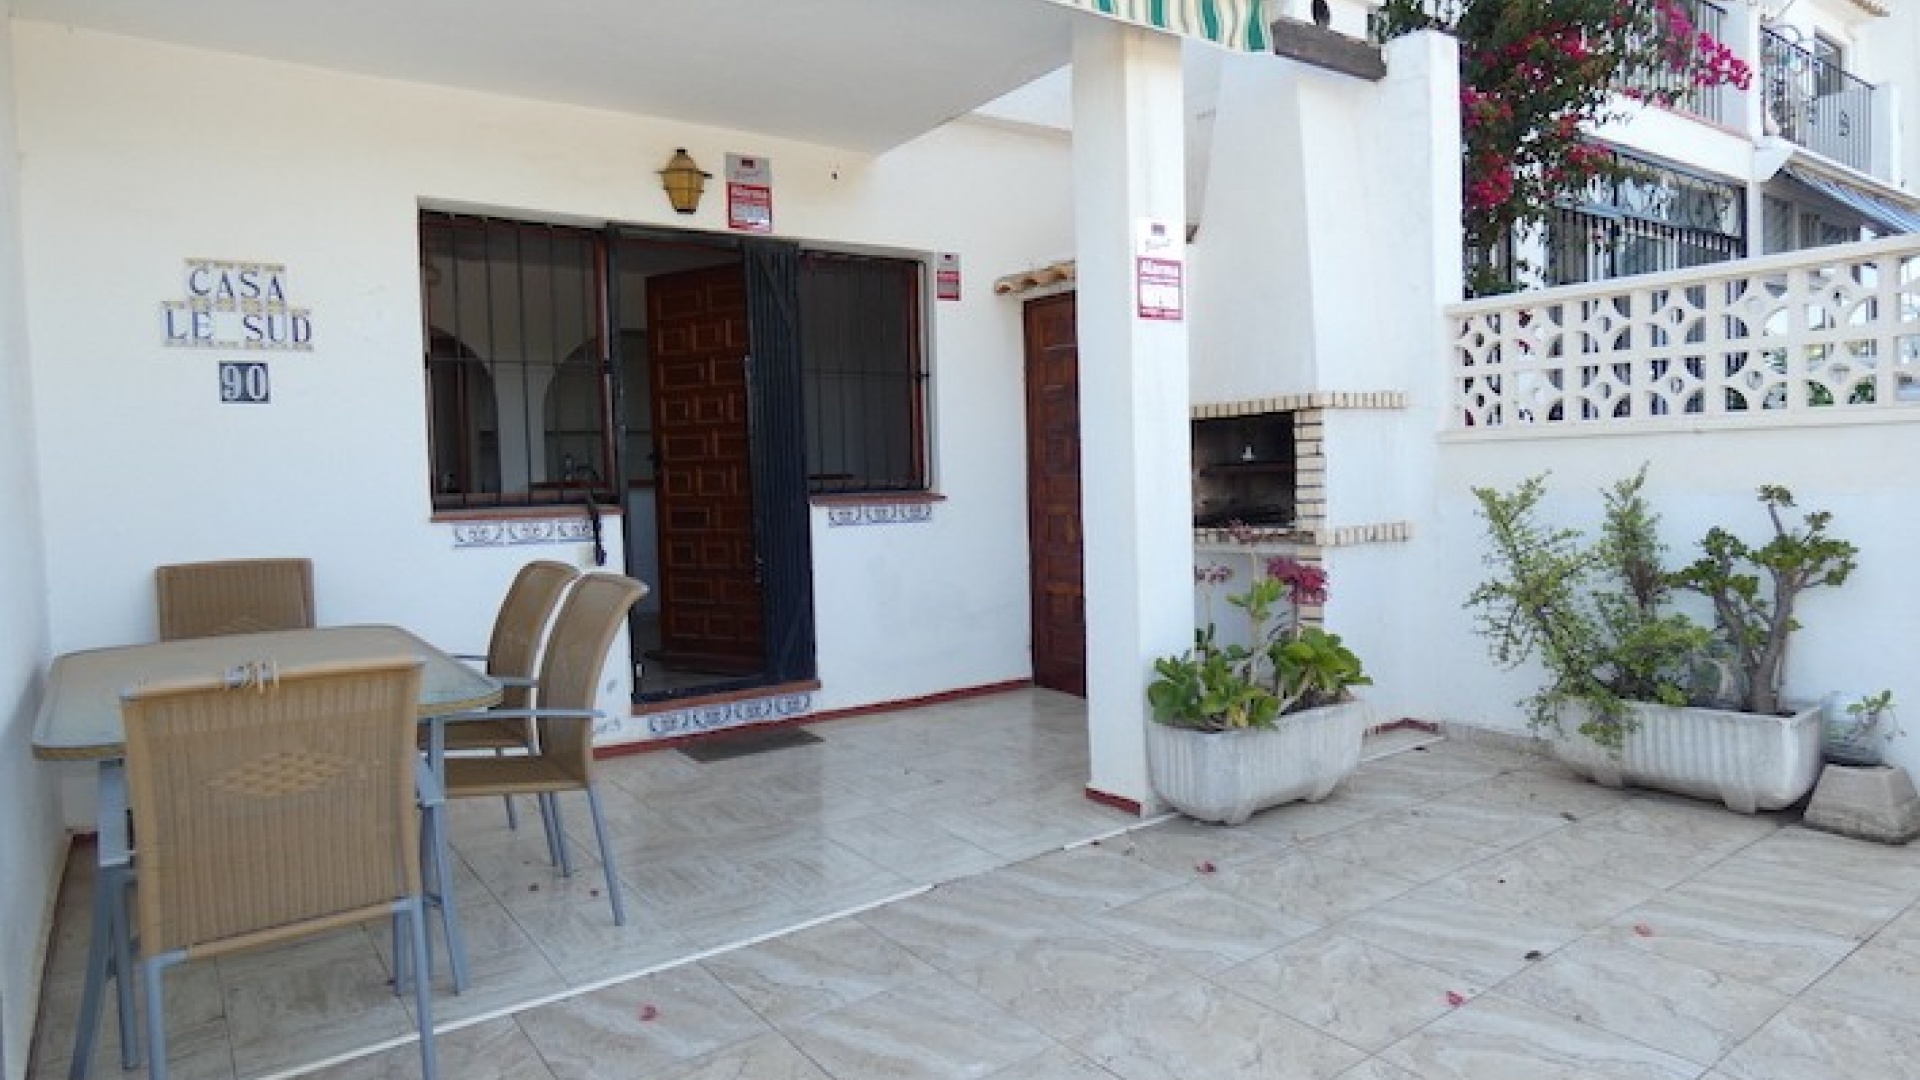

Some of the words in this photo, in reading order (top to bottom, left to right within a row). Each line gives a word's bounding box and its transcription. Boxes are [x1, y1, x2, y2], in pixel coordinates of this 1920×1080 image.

[189, 267, 285, 300] CASA
[165, 310, 212, 340] LE
[243, 312, 312, 344] SUD
[221, 364, 267, 400] 90
